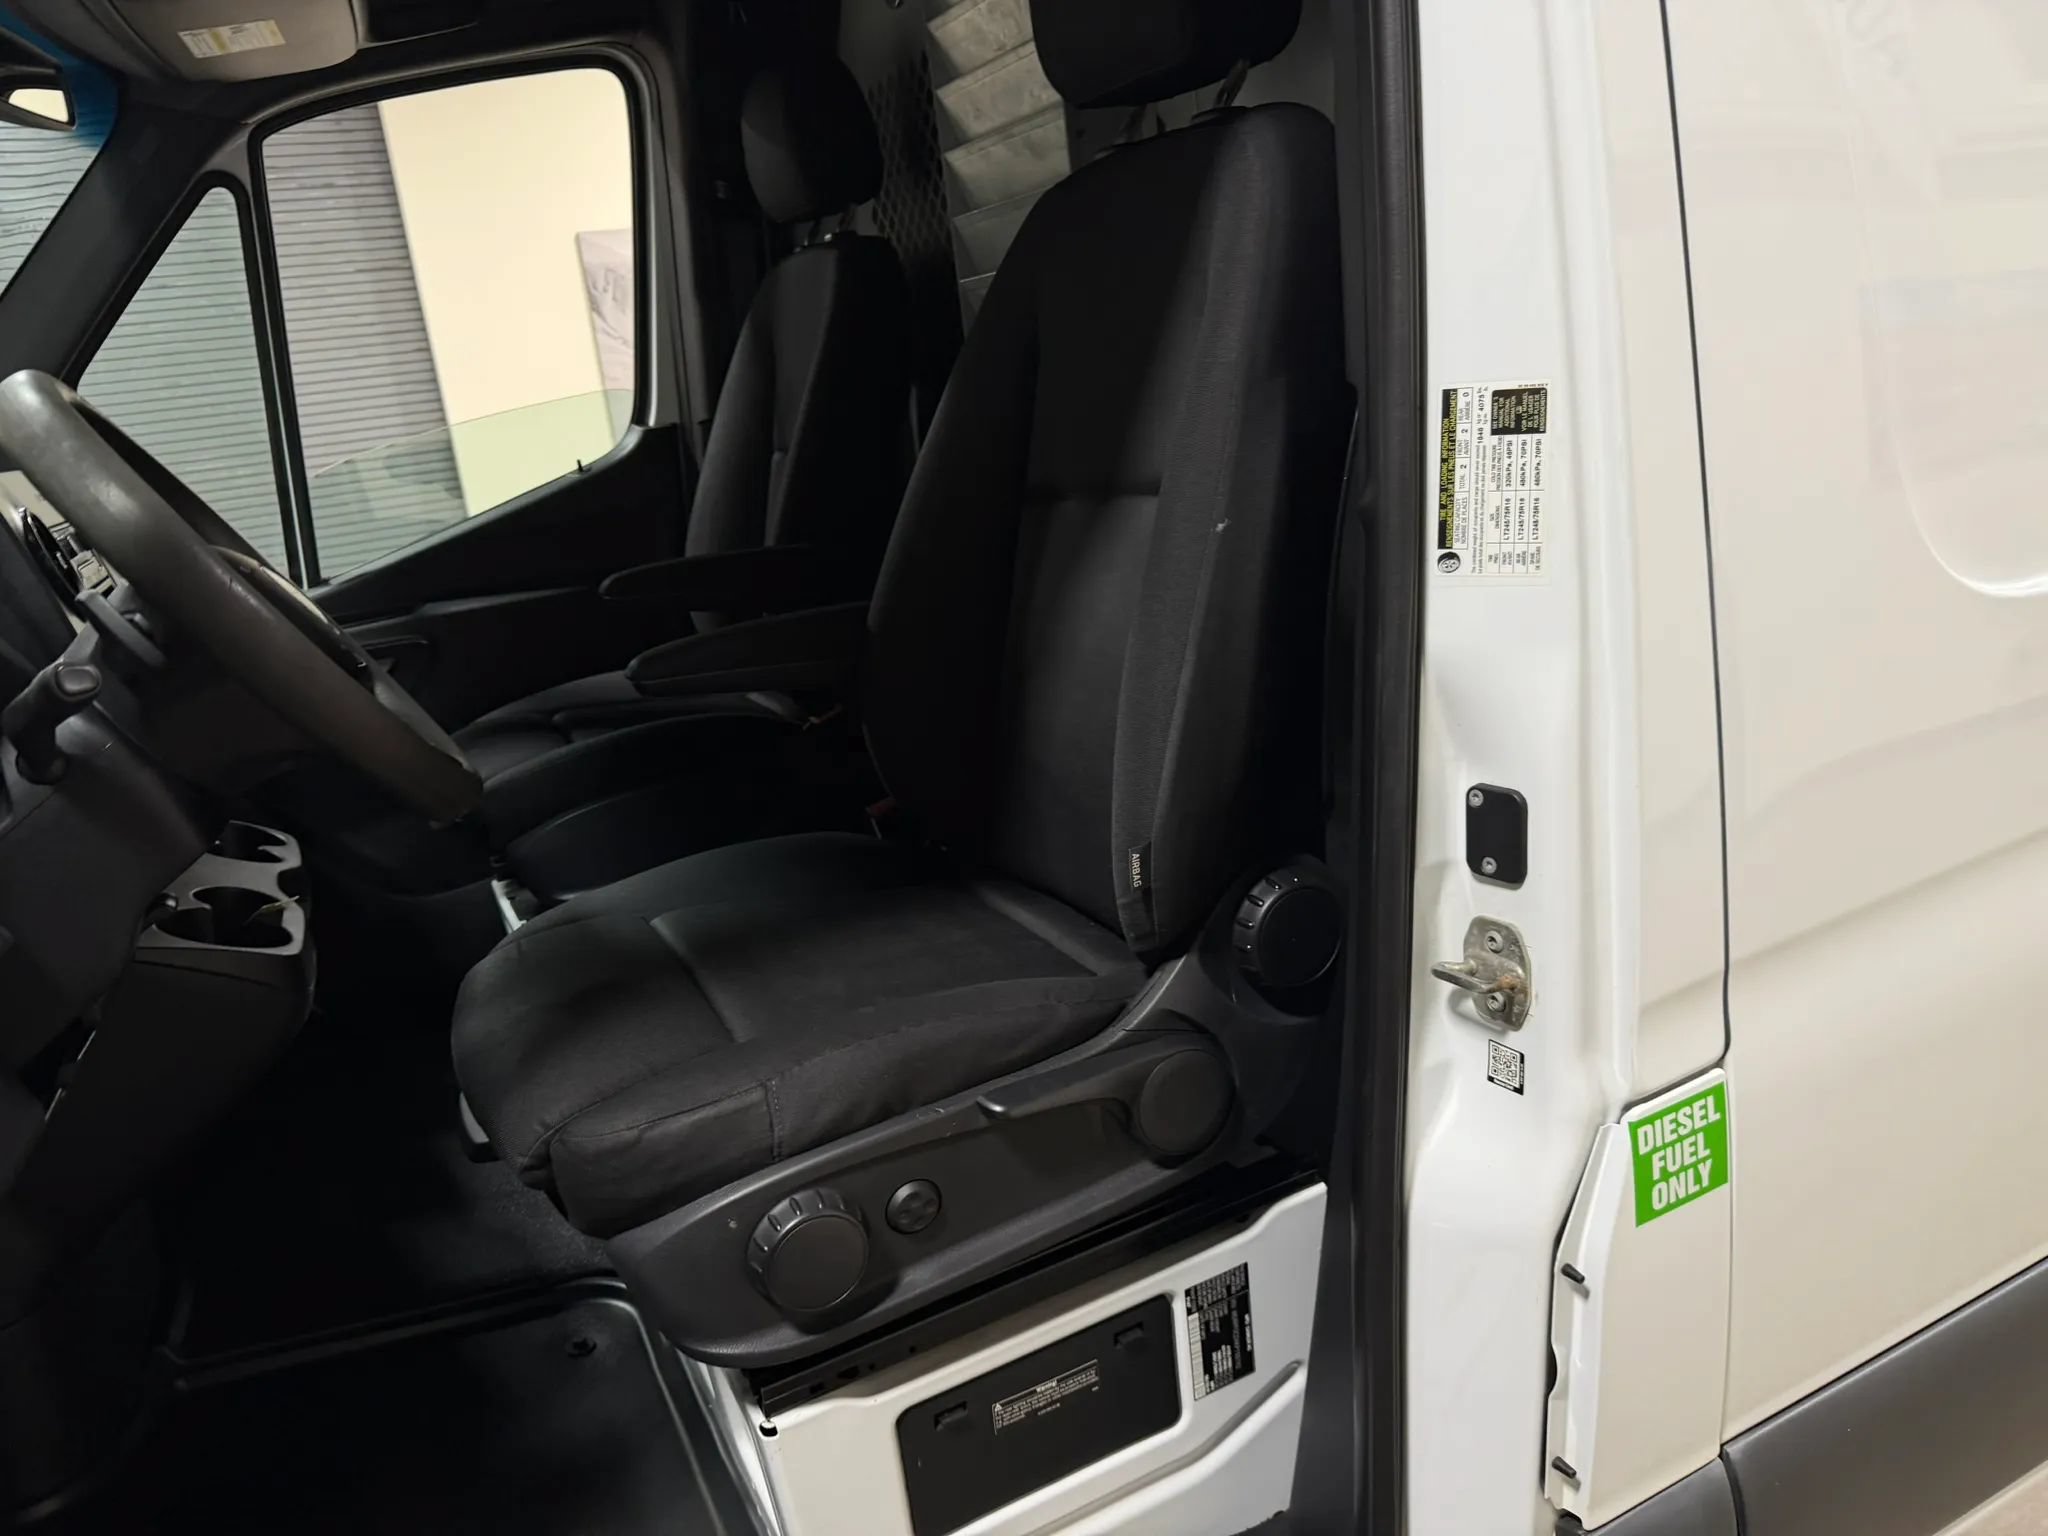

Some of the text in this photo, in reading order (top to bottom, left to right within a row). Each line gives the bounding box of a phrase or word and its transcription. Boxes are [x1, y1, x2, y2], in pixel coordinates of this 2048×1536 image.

[1131, 853, 1142, 888] AIRBAG
[1637, 1095, 1720, 1155] DIESEL
[1652, 1132, 1710, 1180] FUEL
[1652, 1158, 1712, 1211] ONLY
